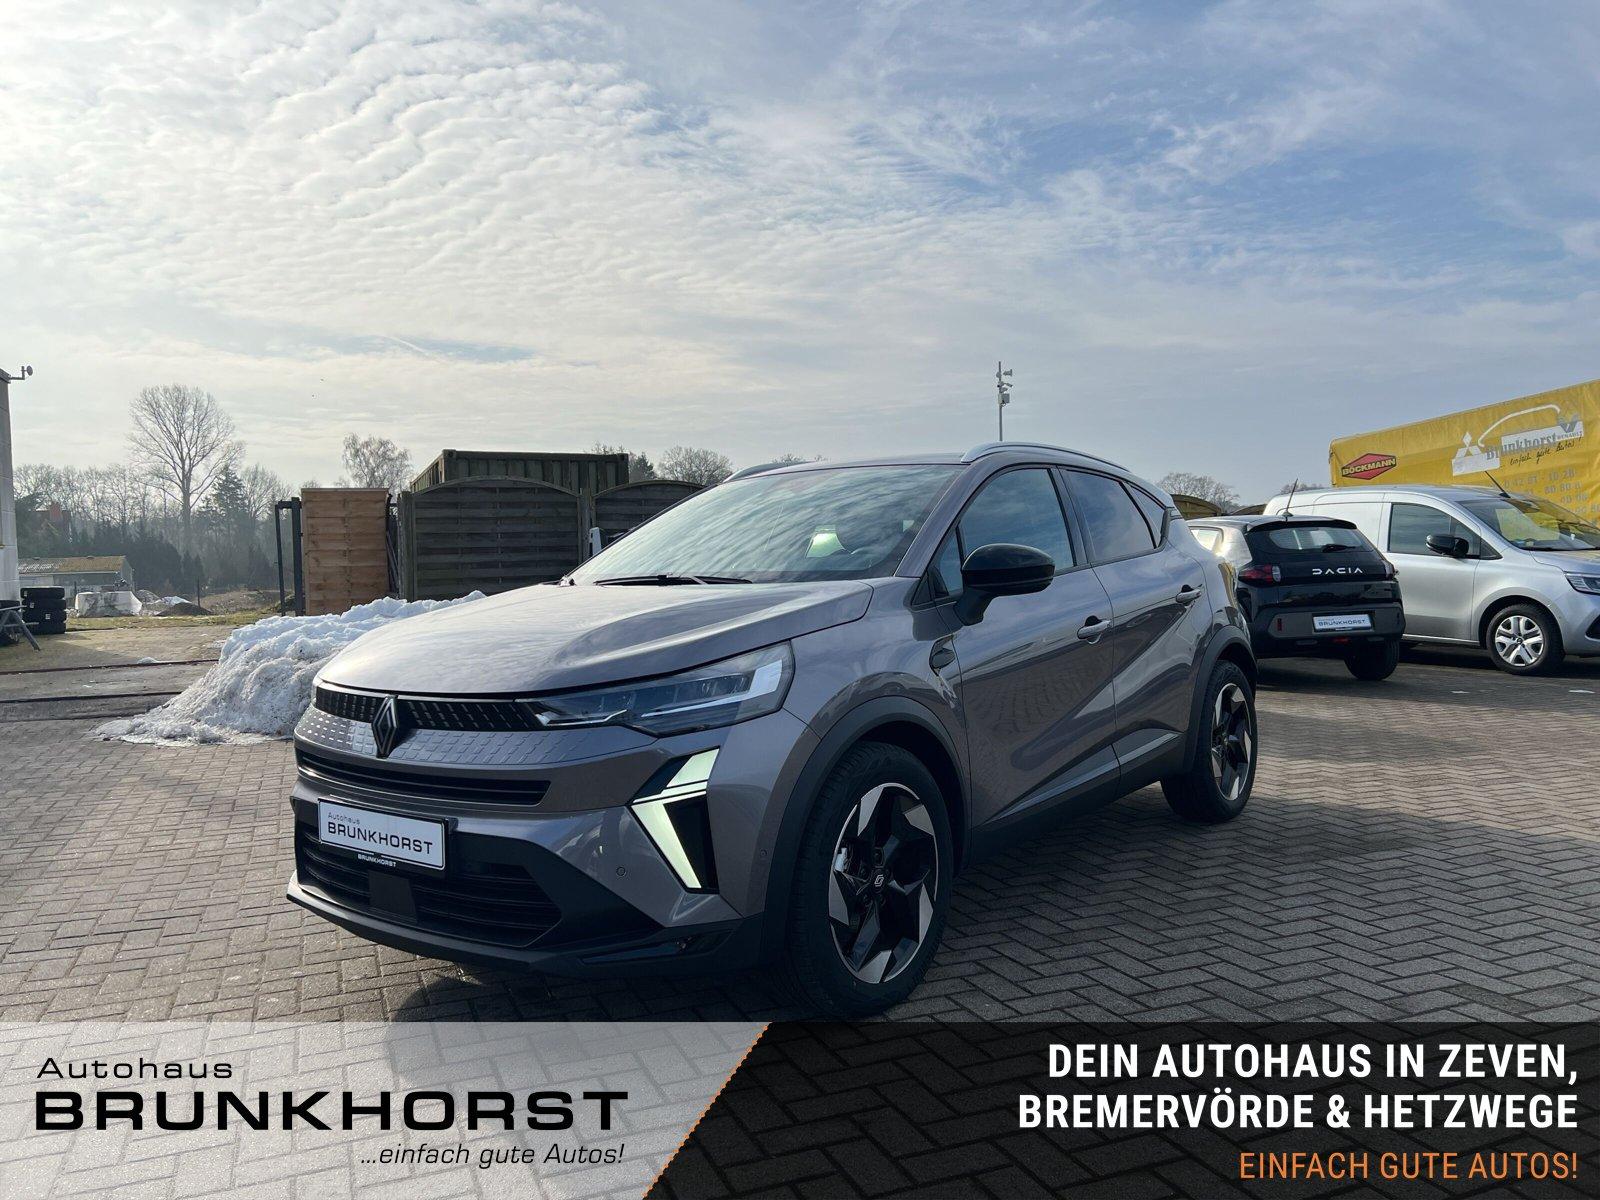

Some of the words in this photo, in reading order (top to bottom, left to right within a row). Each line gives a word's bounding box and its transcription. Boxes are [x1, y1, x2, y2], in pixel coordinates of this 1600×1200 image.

[1312, 567, 1363, 575] DACIA
[1318, 619, 1365, 627] BRUNKHORST
[327, 812, 361, 825] Autohaus
[327, 821, 433, 855] BRUNKHORST
[357, 853, 397, 868] BRUNKHORST
